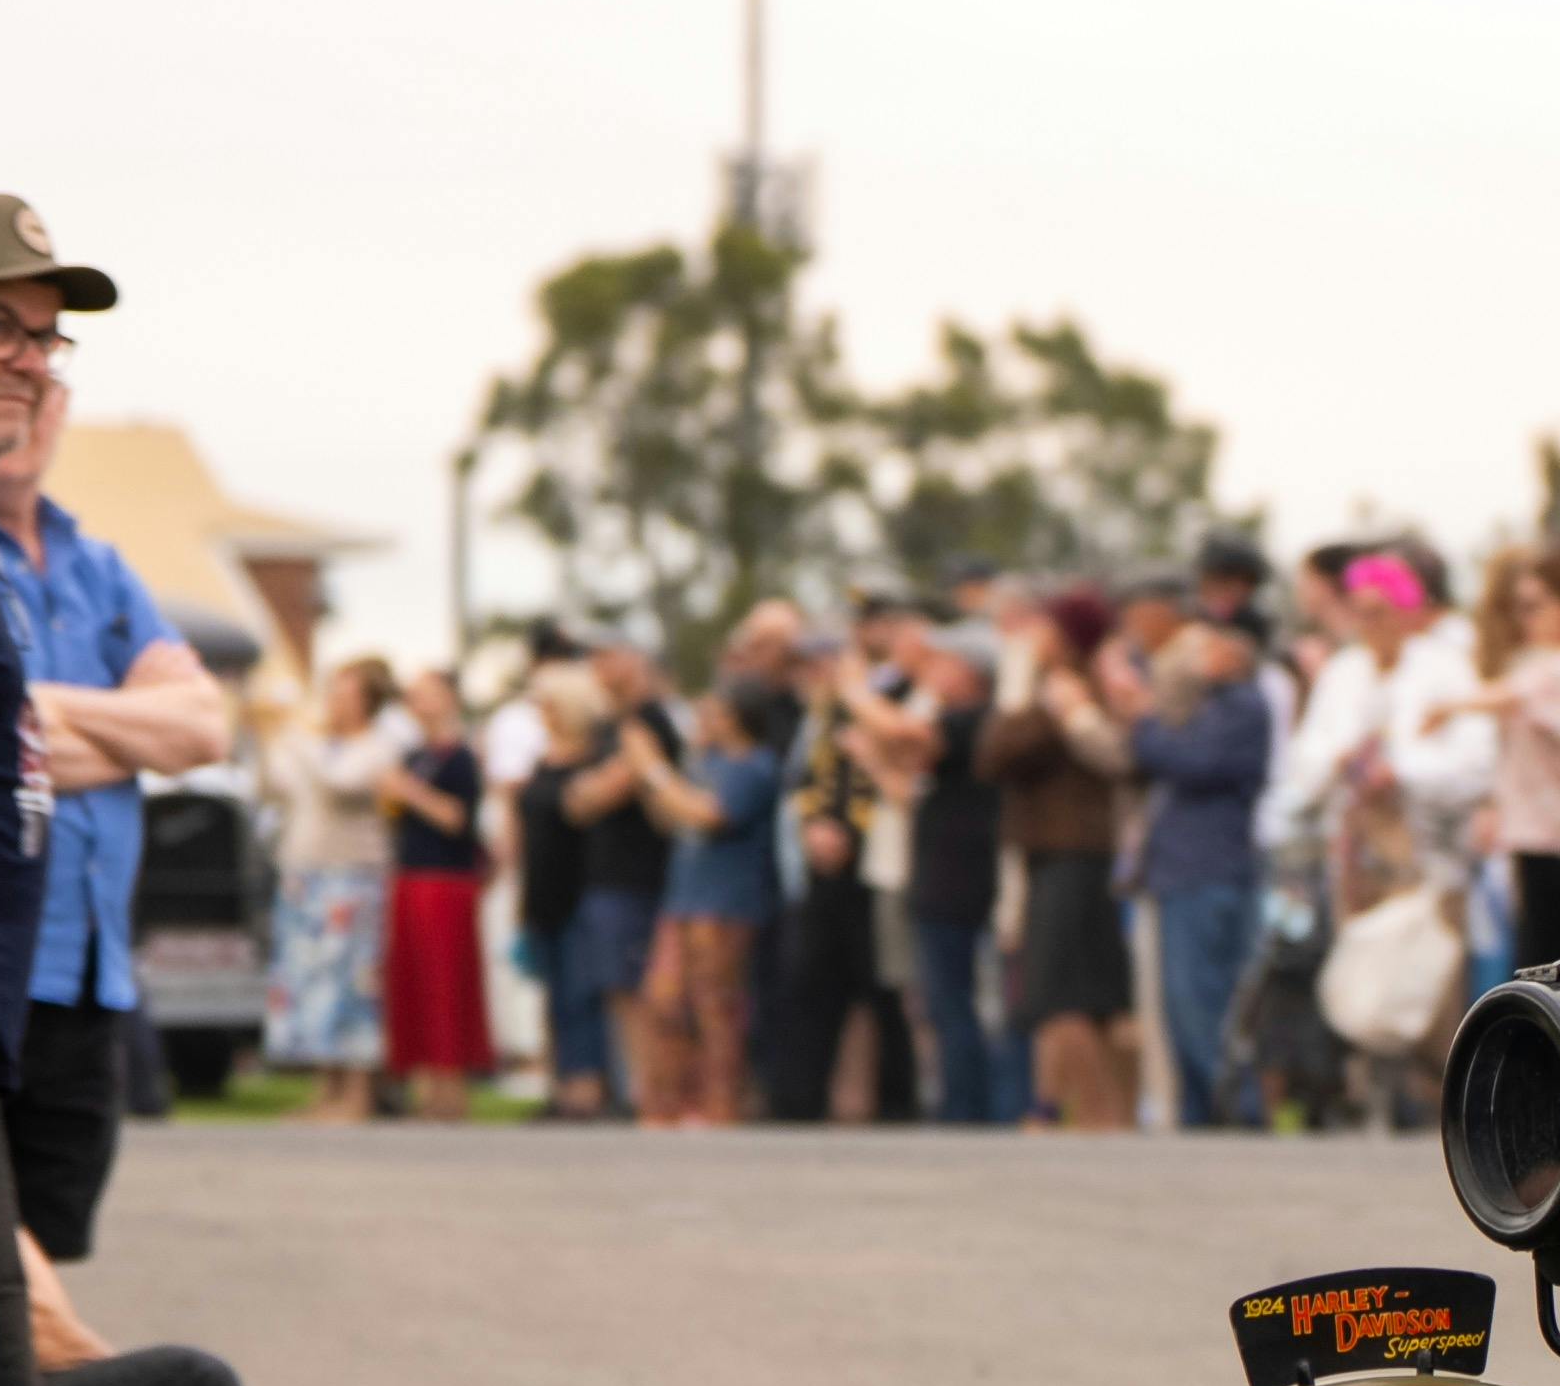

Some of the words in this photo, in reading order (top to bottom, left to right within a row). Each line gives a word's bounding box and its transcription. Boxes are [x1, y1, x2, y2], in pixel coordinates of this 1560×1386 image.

[1243, 1296, 1285, 1318] 1924
[1334, 1307, 1452, 1353] DAVIDSON
[1383, 1330, 1486, 1360] Superspeed
